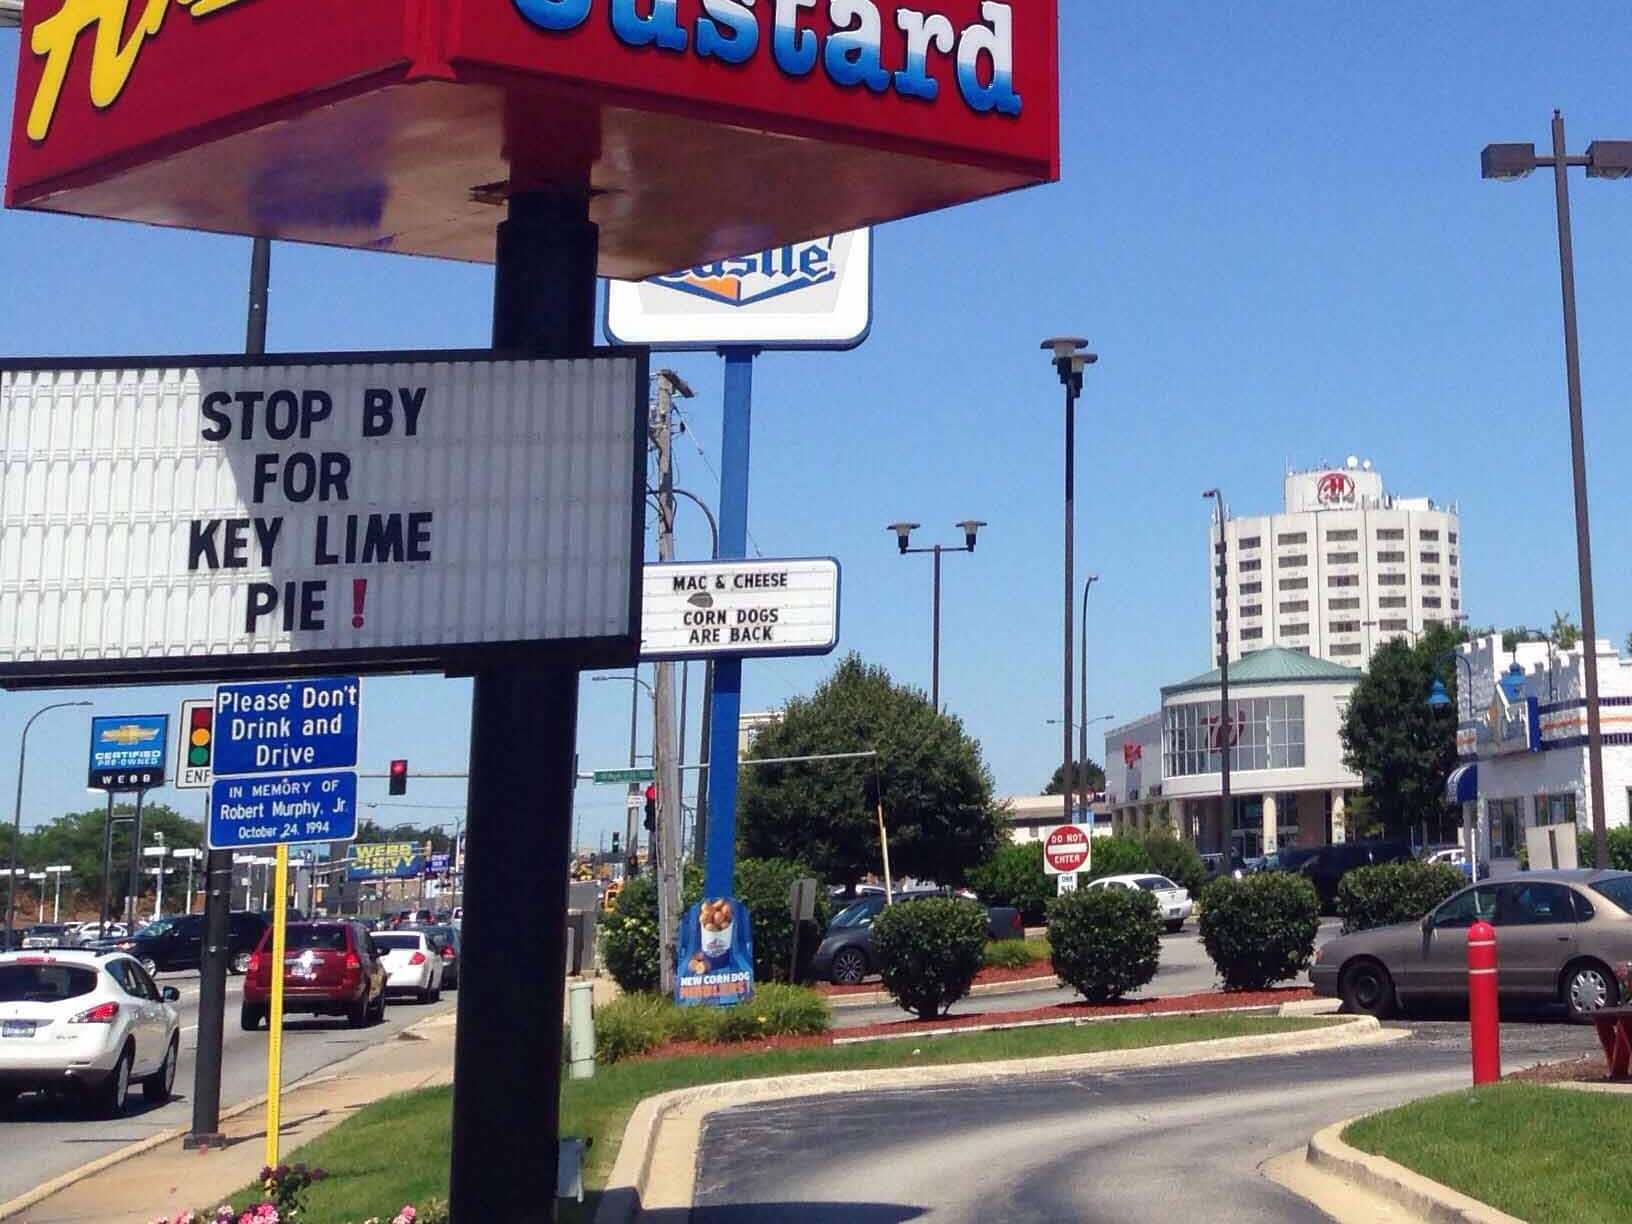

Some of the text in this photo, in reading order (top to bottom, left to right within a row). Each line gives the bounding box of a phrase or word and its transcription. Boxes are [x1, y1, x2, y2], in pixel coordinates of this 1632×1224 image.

[201, 387, 427, 442] STOP BY
[253, 452, 352, 503] FOR
[188, 512, 432, 570] KEY LIME
[673, 573, 788, 591] MAC & CHEESE
[684, 609, 779, 625] CORN DOGS
[689, 626, 773, 643] ARE BACK
[218, 685, 357, 714] Please Don't
[232, 714, 342, 741] Drink and
[95, 750, 161, 760] CERTIFIED
[256, 744, 315, 767] Drive
[229, 779, 340, 798] IN MEMORY OF
[220, 803, 264, 820] Robert
[238, 826, 278, 839] October
[306, 821, 330, 834] 1994
[1051, 833, 1083, 844] DO NOT
[1054, 854, 1080, 865] ENTER
[680, 976, 702, 986] NEW
[704, 974, 730, 984] CORN
